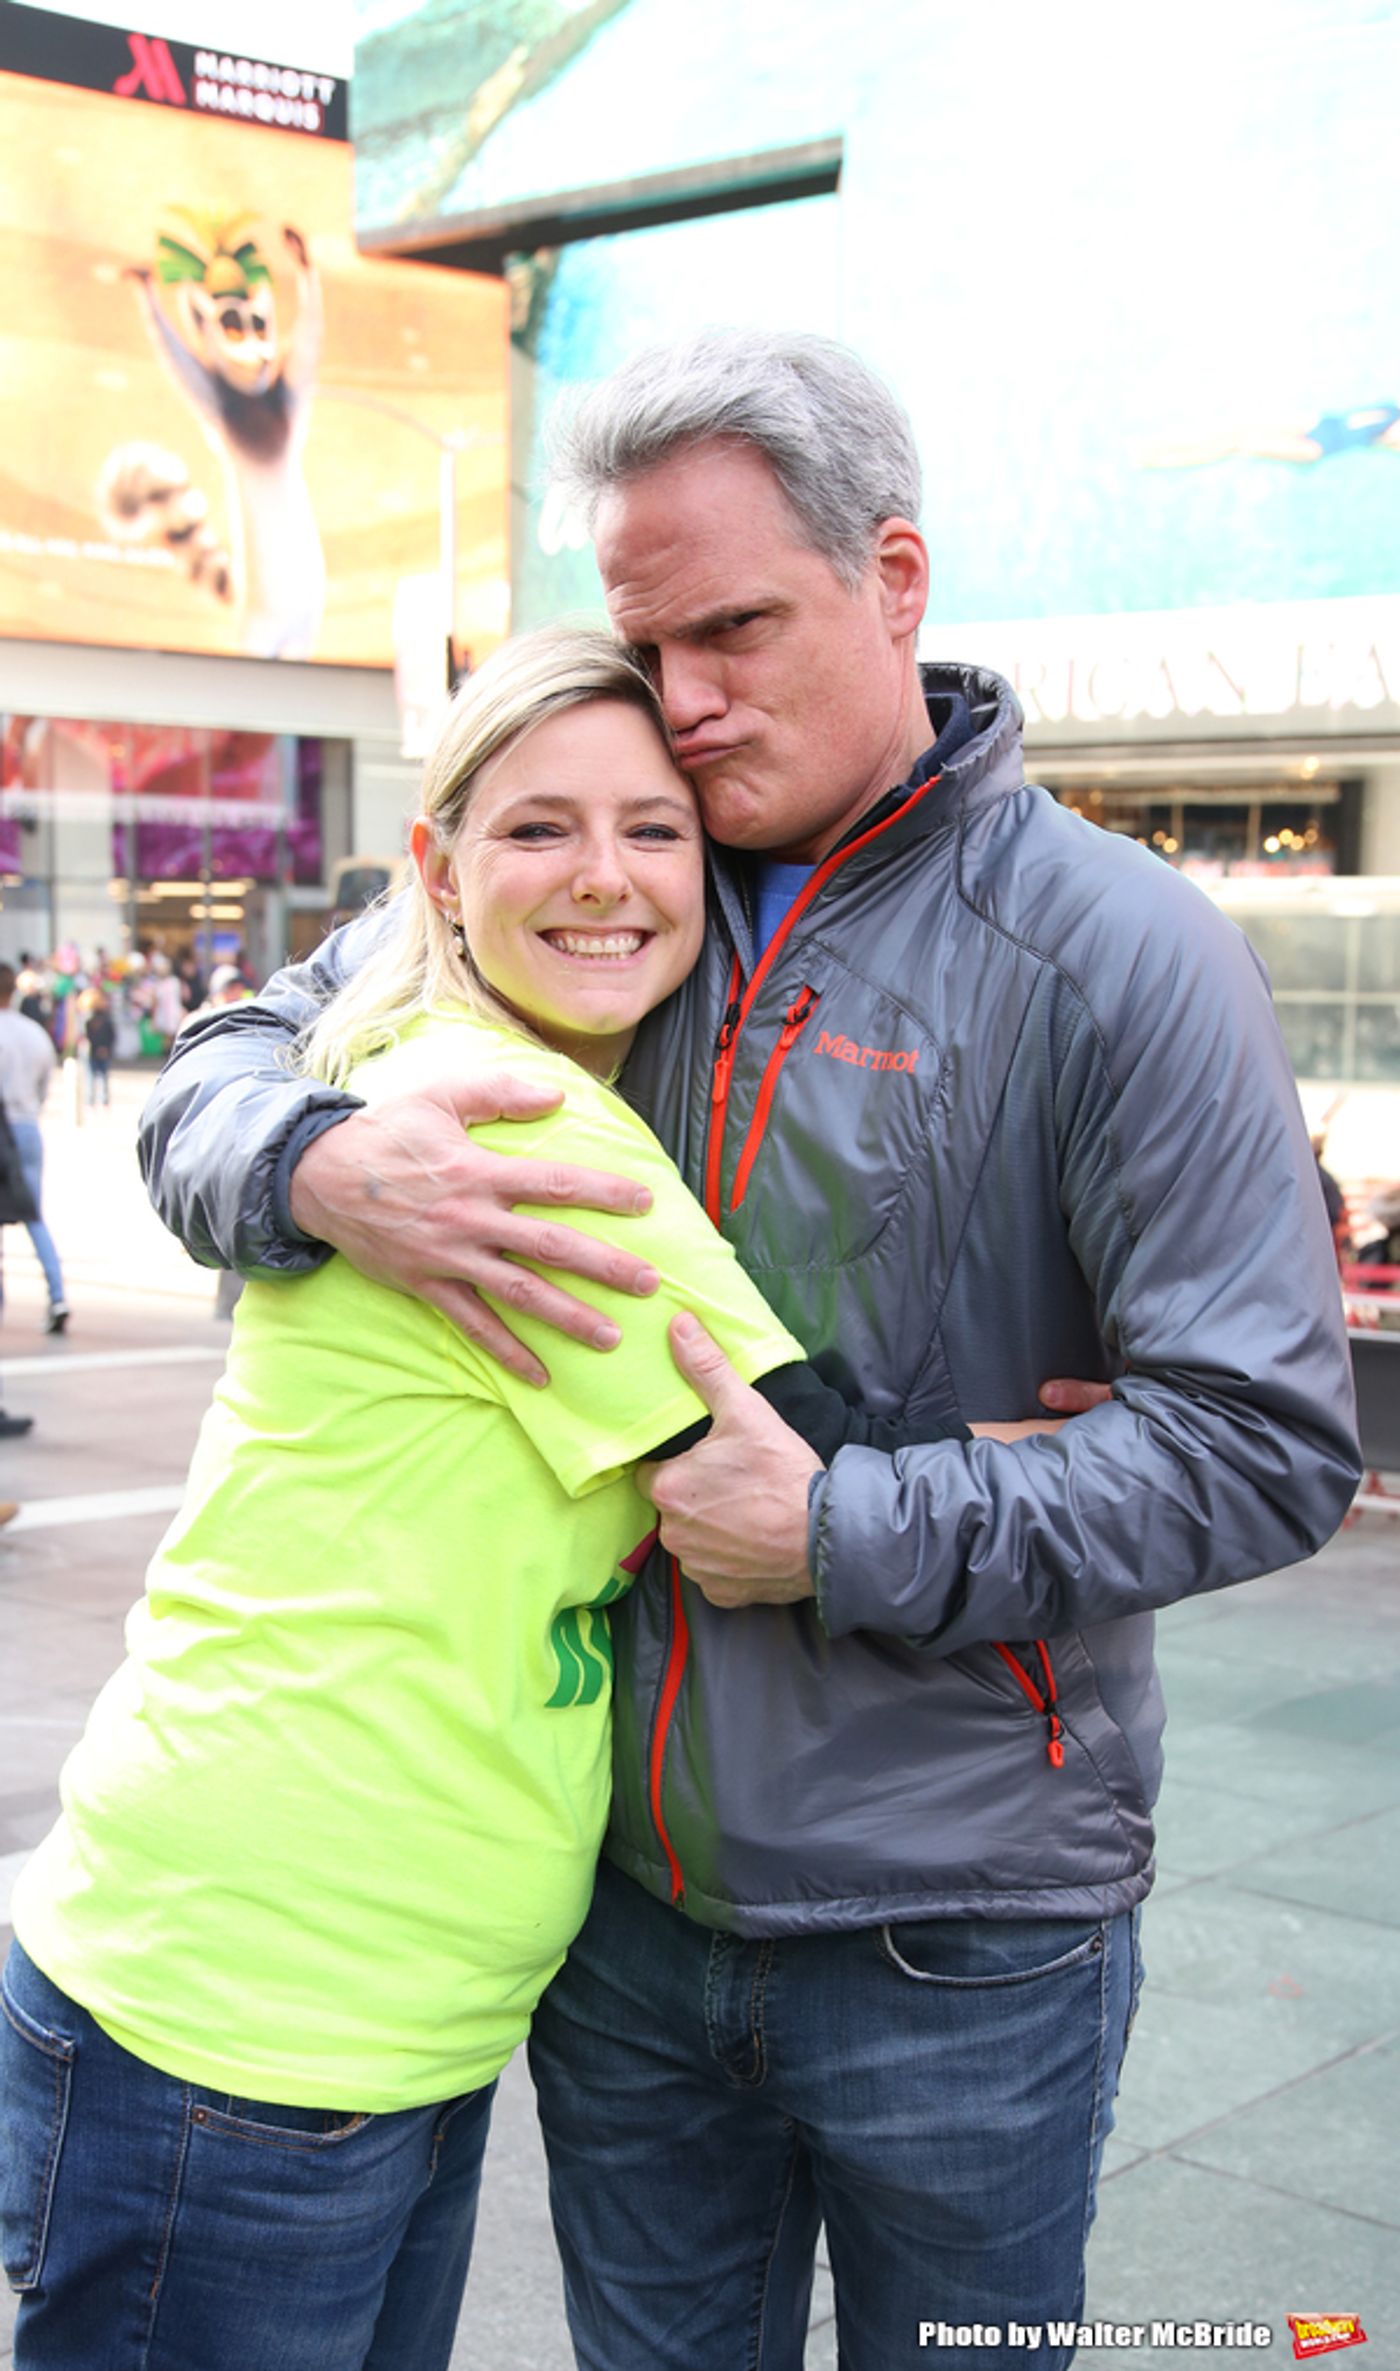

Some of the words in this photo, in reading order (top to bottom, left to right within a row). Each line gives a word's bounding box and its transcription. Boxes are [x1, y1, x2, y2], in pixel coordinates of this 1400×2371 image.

[194, 50, 335, 106] MARRIOTT
[194, 79, 321, 131] MARQUIS
[813, 1030, 919, 1073] Marmot
